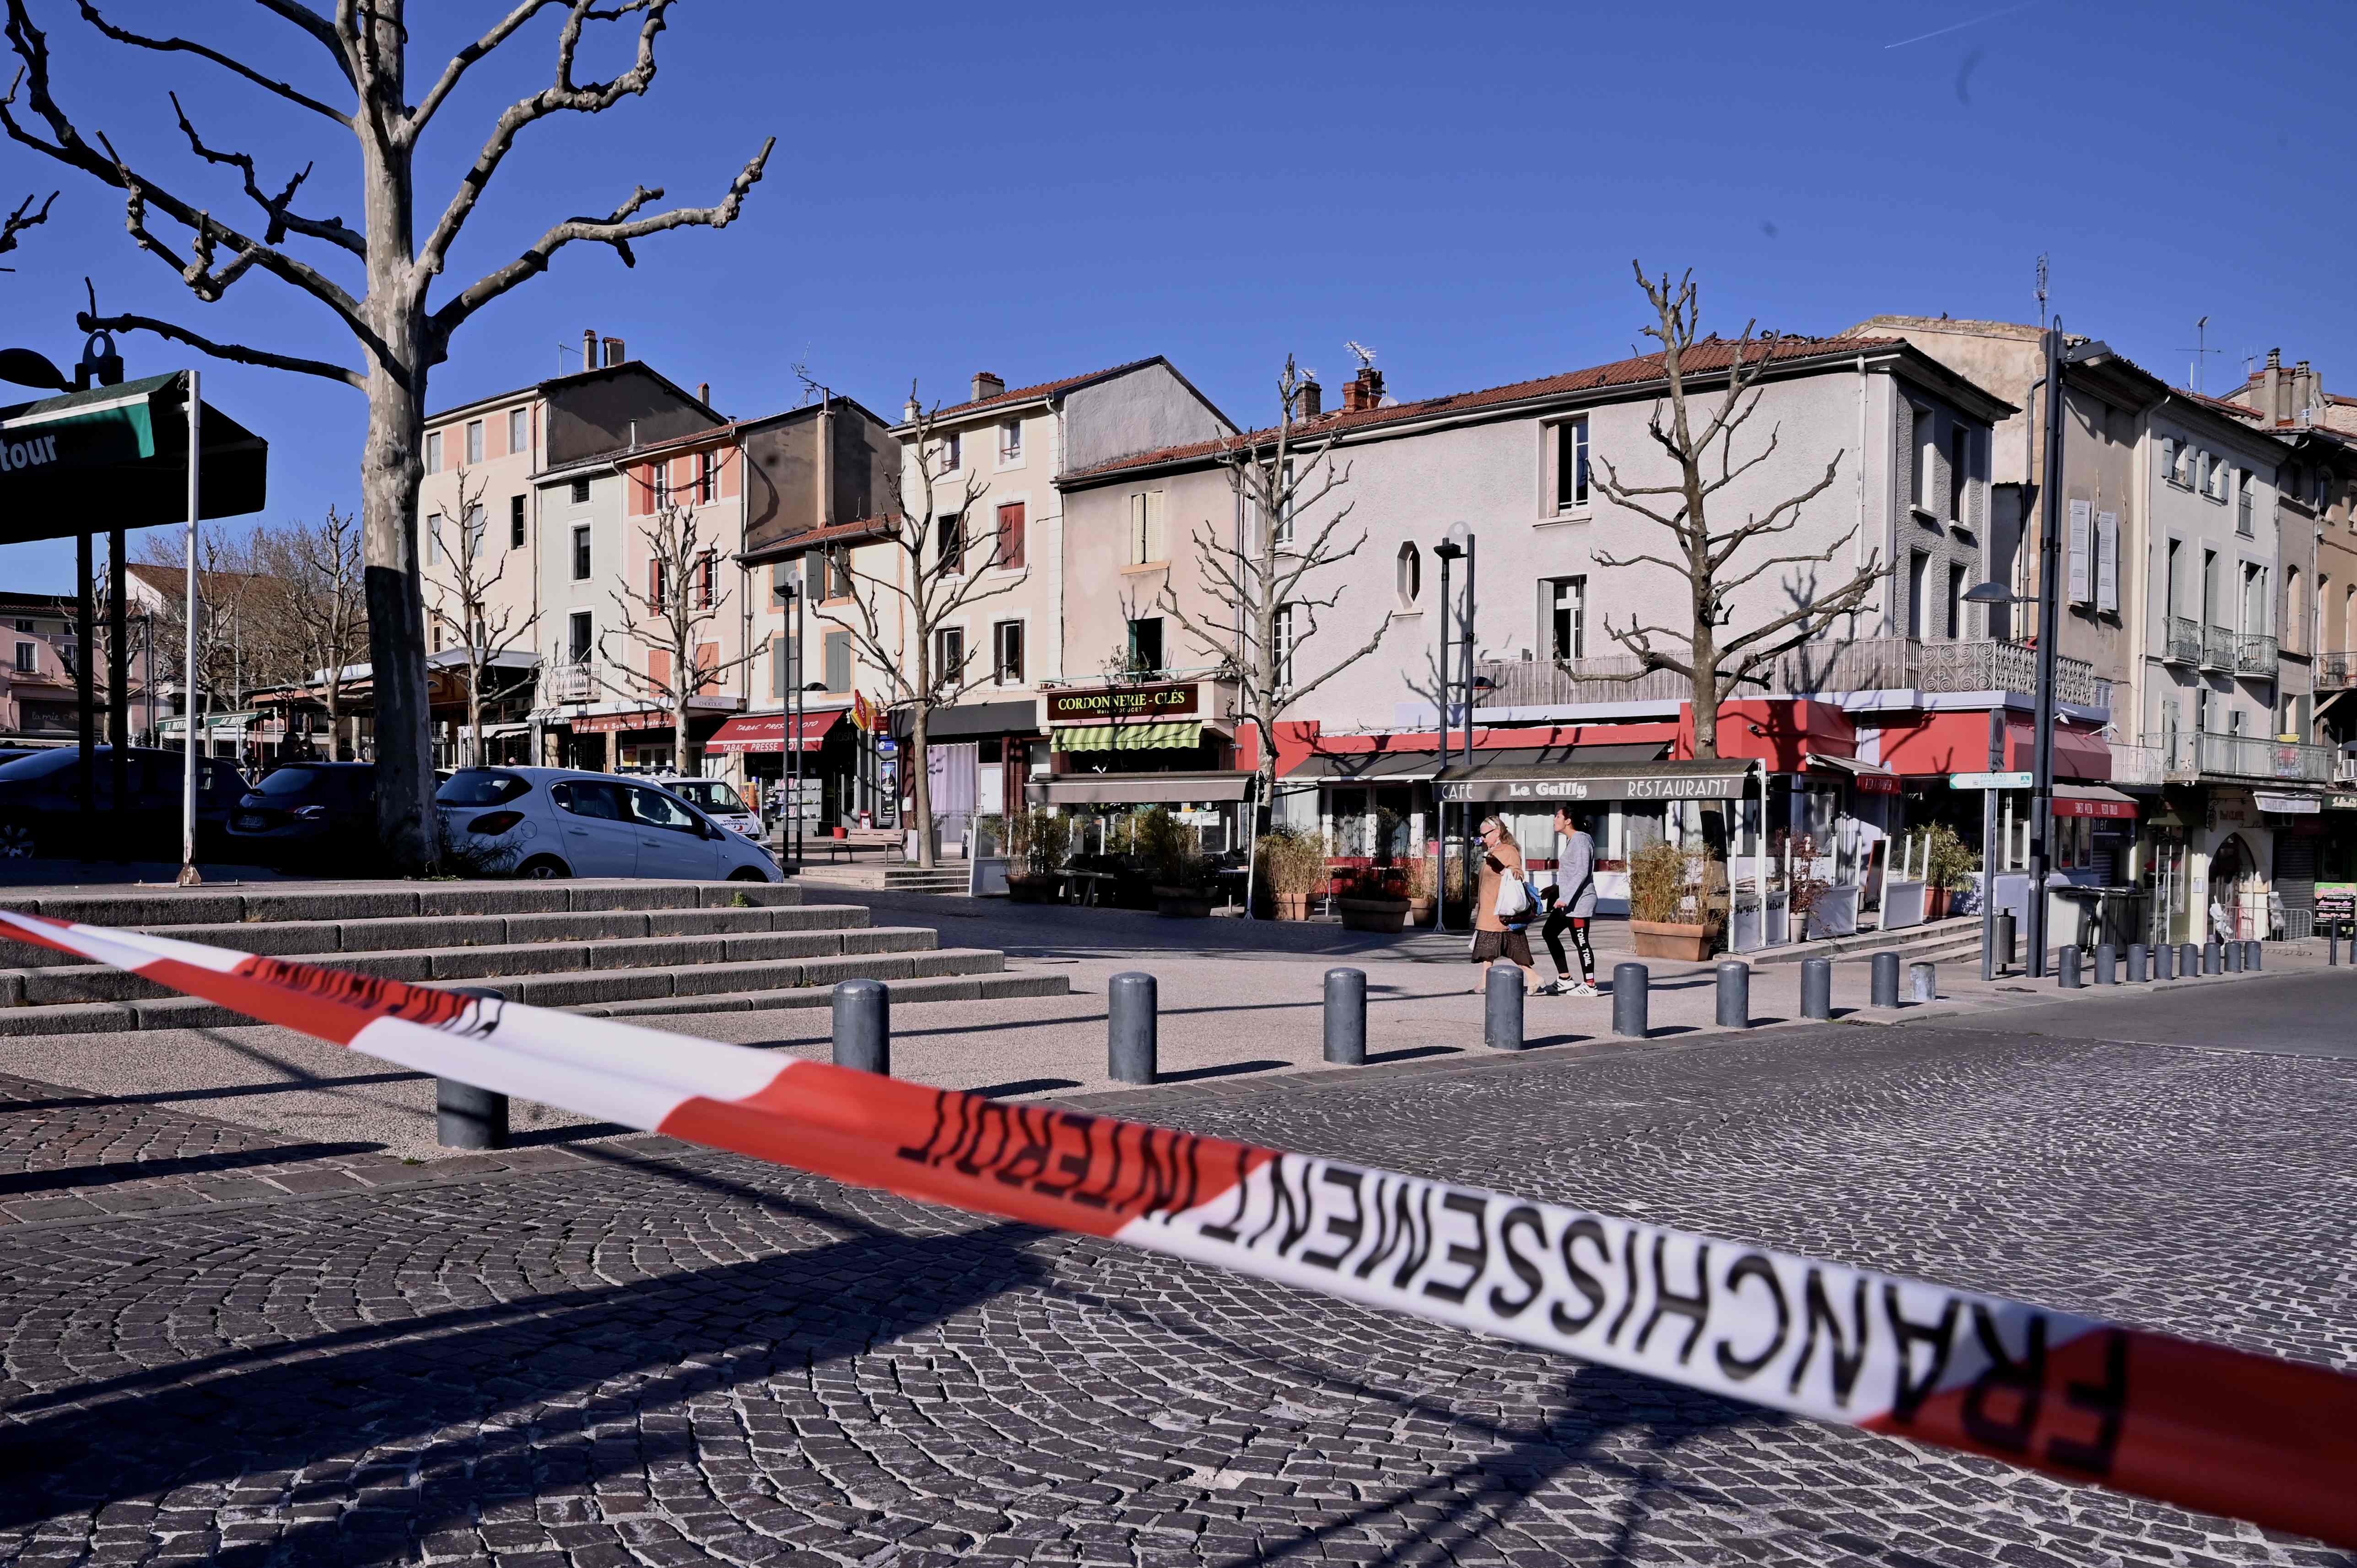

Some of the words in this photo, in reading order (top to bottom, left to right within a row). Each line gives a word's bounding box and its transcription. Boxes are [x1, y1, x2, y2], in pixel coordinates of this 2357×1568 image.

[1058, 694, 1146, 710] CORDONNERIE
[1154, 689, 1185, 705] CLÉS
[229, 716, 248, 724] ROYAL
[165, 722, 171, 731] LE
[172, 721, 186, 730] ROYA
[764, 722, 793, 730] PRES
[750, 743, 778, 751] PRESSE
[1442, 782, 1473, 799] CAFÉ
[1509, 783, 1531, 796] Le
[1535, 782, 1587, 798] Gailly
[1627, 779, 1730, 797] RESTAURANT
[1735, 905, 1759, 916] Burgers
[897, 1091, 1200, 1225] INTERDIT
[1199, 1147, 2128, 1476] FRANCHISSEMENT
